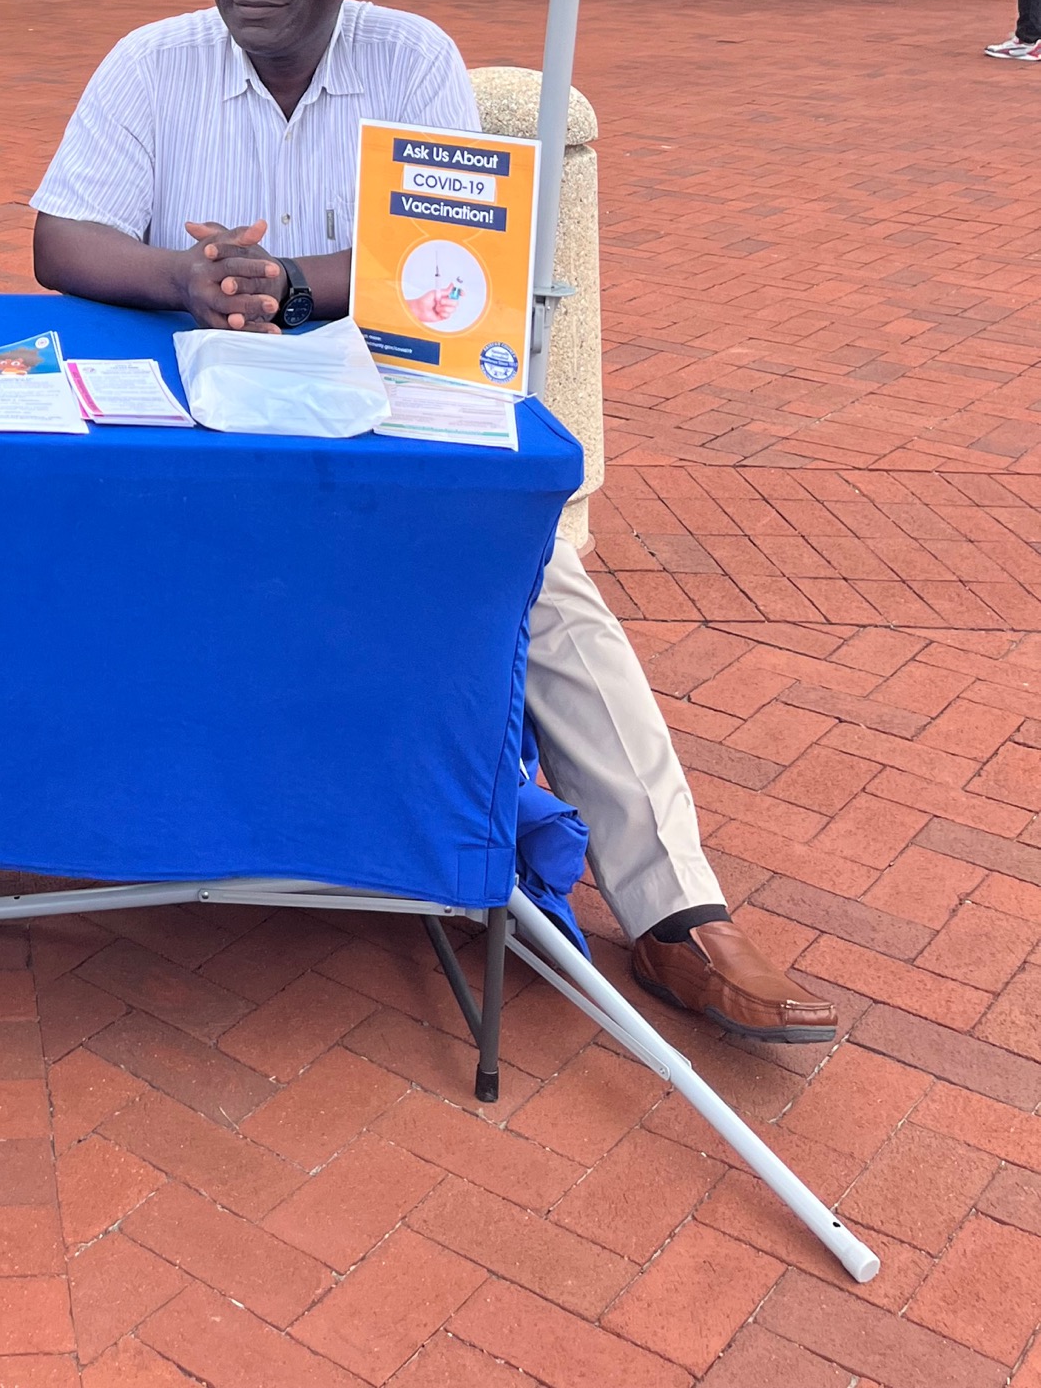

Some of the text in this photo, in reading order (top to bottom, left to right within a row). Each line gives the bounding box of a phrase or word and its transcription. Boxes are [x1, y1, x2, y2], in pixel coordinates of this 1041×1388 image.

[403, 143, 499, 169] Ask Us About
[413, 173, 485, 195] COVID-19
[401, 196, 494, 223] Vaccination!
